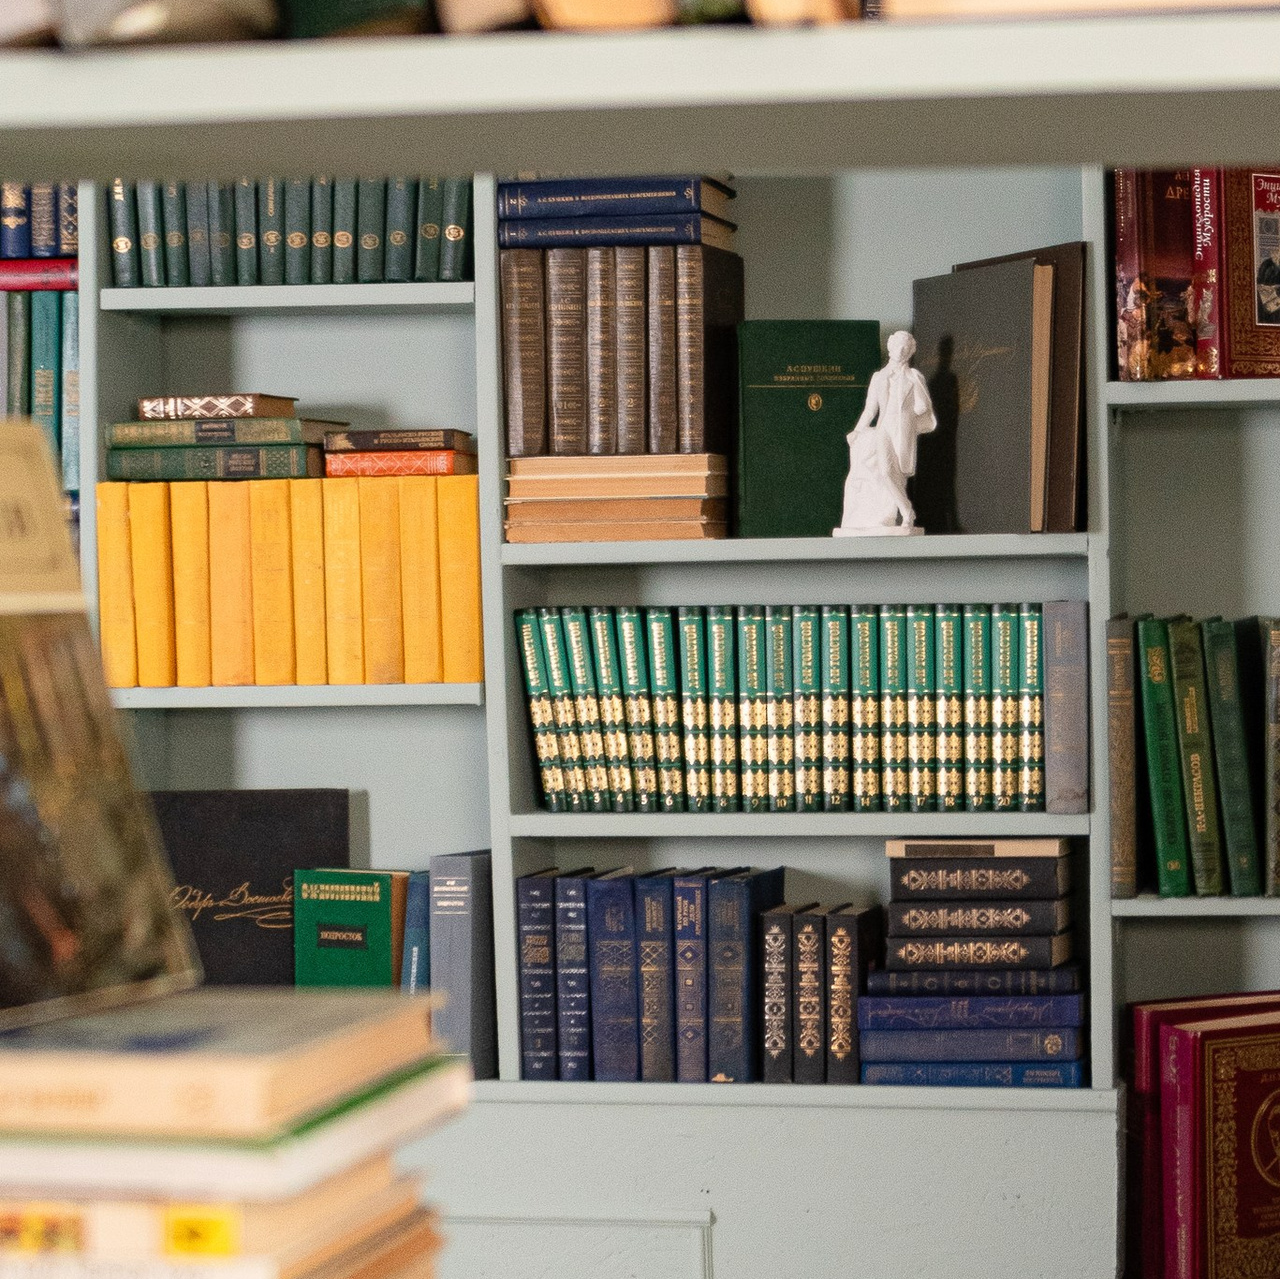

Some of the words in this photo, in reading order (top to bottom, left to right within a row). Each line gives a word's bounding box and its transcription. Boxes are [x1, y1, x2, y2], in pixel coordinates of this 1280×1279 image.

[1195, 168, 1205, 261] Энциклопедия
[1202, 178, 1213, 247] Мудрости
[551, 794, 557, 803] 1
[572, 794, 579, 803] 2
[593, 793, 601, 803] 3
[616, 793, 623, 803] 4
[641, 794, 648, 804] 5
[665, 795, 673, 805] 6
[696, 797, 703, 807] 7
[720, 797, 727, 807] 8
[752, 797, 759, 808] 9
